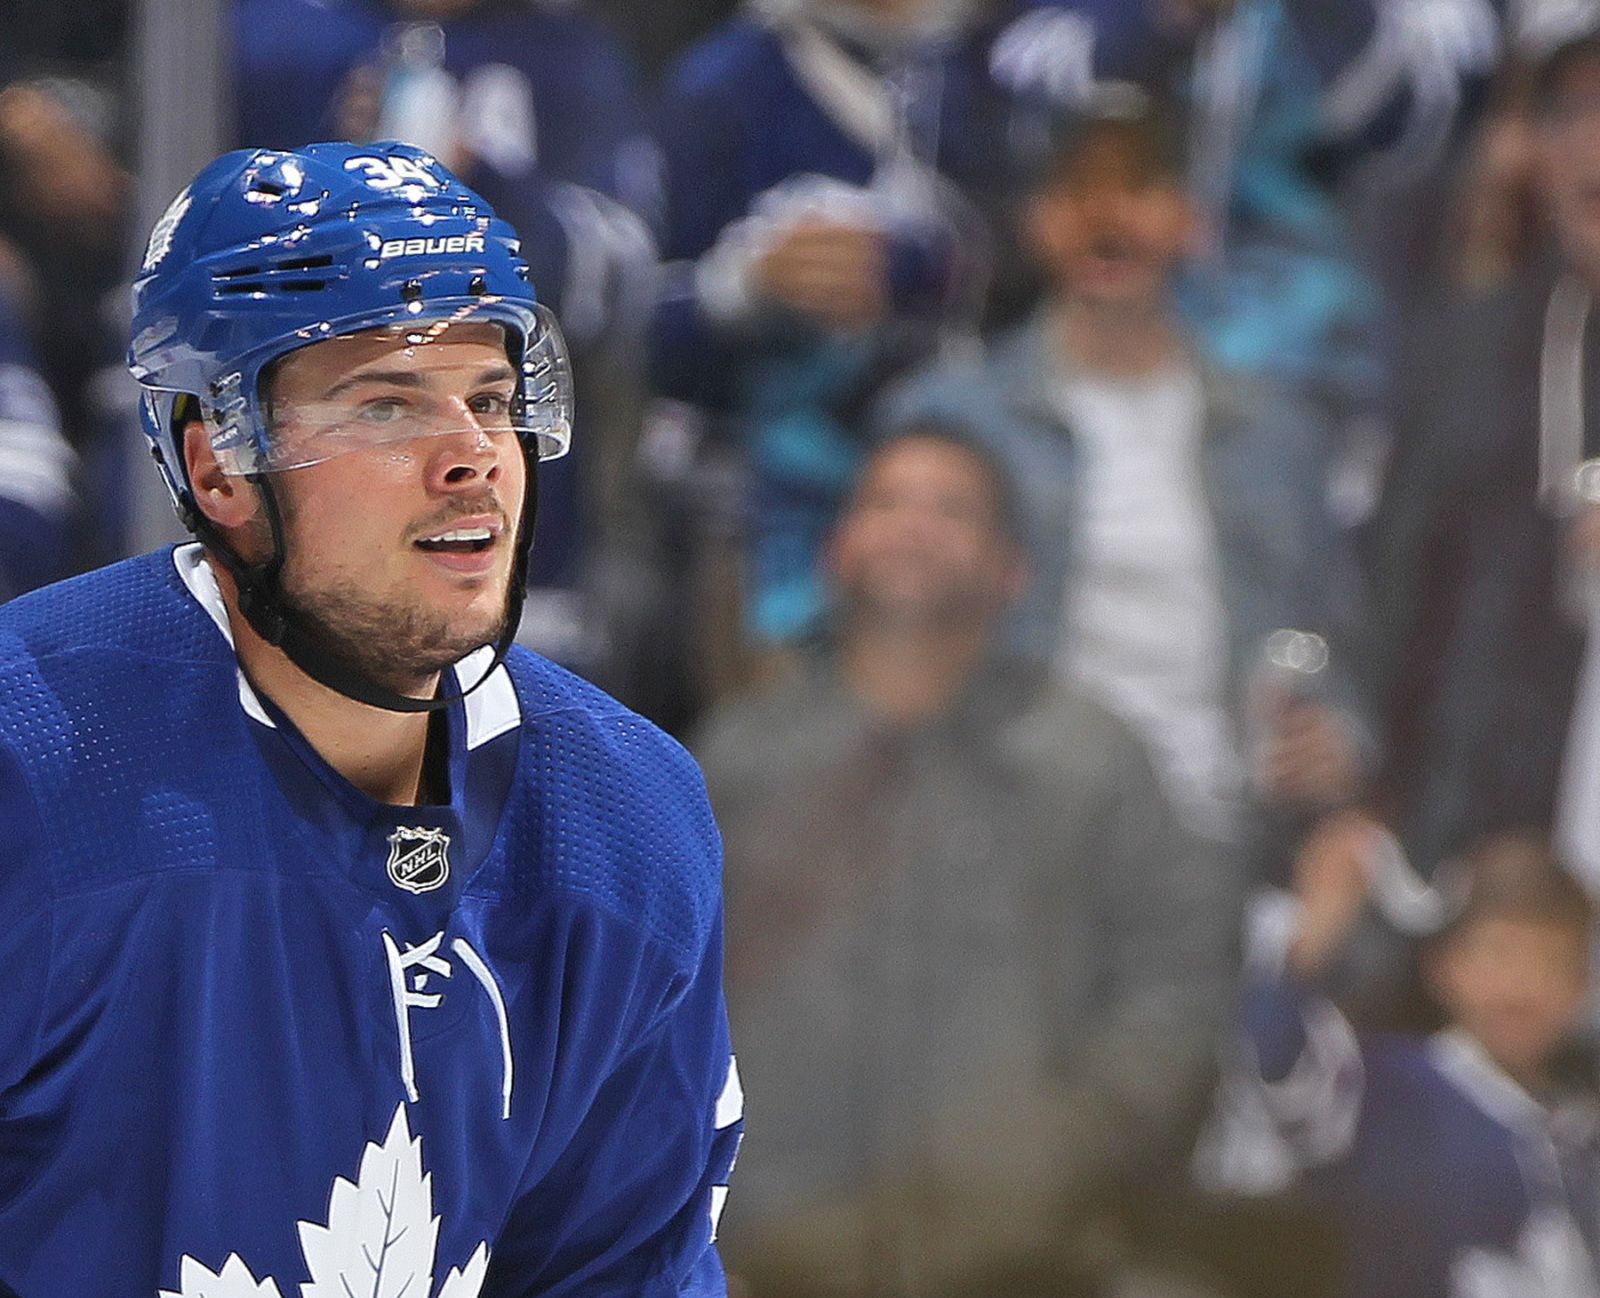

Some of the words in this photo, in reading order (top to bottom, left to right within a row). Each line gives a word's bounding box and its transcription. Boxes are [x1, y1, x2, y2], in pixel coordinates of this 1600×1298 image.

[343, 154, 441, 190] 34
[381, 234, 485, 259] BAUER
[401, 847, 437, 876] NHL
